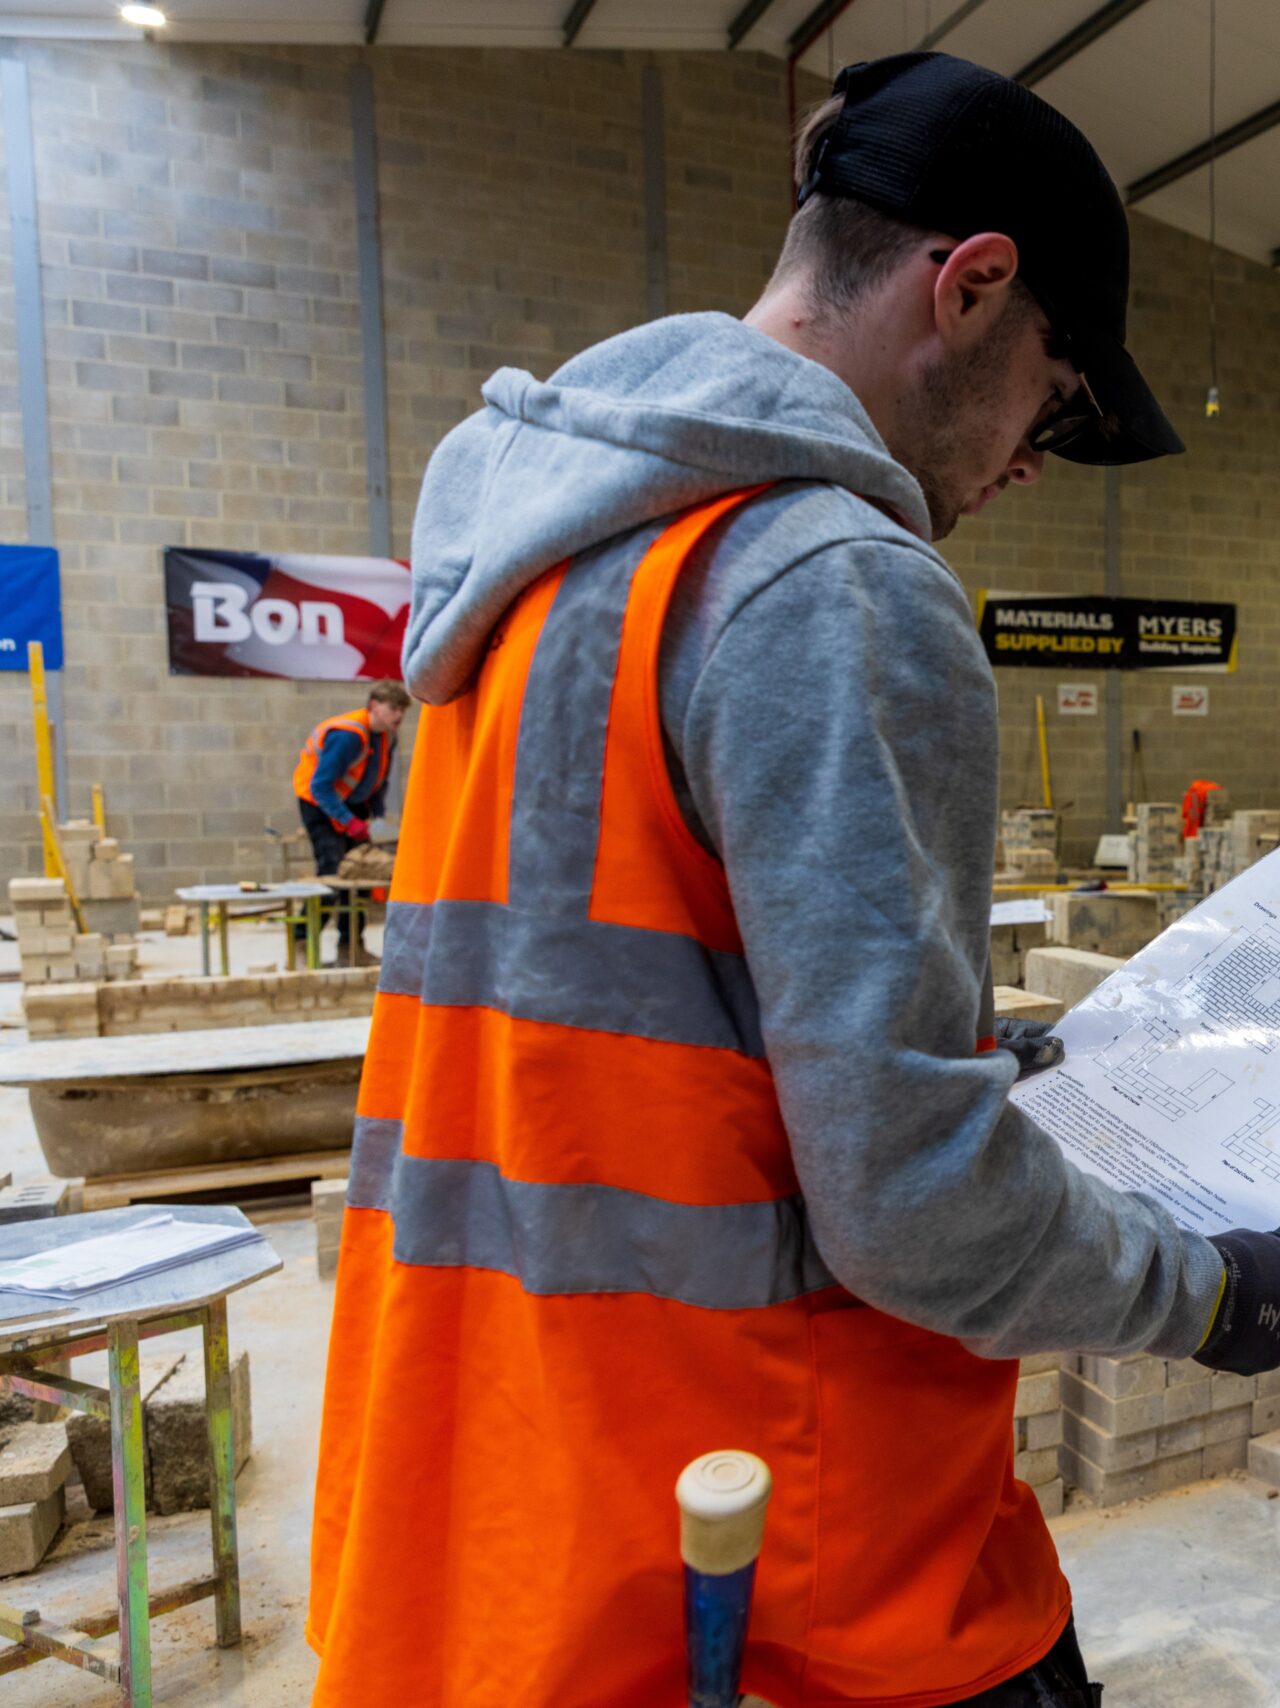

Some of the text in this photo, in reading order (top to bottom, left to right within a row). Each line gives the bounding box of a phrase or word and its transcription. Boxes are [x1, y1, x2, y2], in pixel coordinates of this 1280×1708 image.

[190, 581, 345, 645] Bon
[995, 609, 1114, 630] MATERIALS
[1138, 616, 1222, 636] MYERS
[995, 633, 1123, 653] SUPPLIED BY
[1253, 901, 1277, 919] Drawings
[1069, 1102, 1088, 1115] spacing
[1099, 1123, 1116, 1134] exceed
[1087, 1106, 1106, 1119] installed
[1105, 1119, 1119, 1128] above
[1105, 1111, 1122, 1123] building
[1121, 1122, 1146, 1140] regulations
[1034, 1094, 1057, 1109] exceeding
[1126, 1158, 1143, 1169] course
[1081, 1151, 1098, 1162] course
[1098, 1155, 1118, 1169] building
[1121, 1147, 1141, 1161] building
[1139, 1160, 1166, 1178] regulations
[1195, 1198, 1213, 1211] reveals
[1129, 1169, 1149, 1183] building
[1147, 1182, 1174, 1200] regulations
